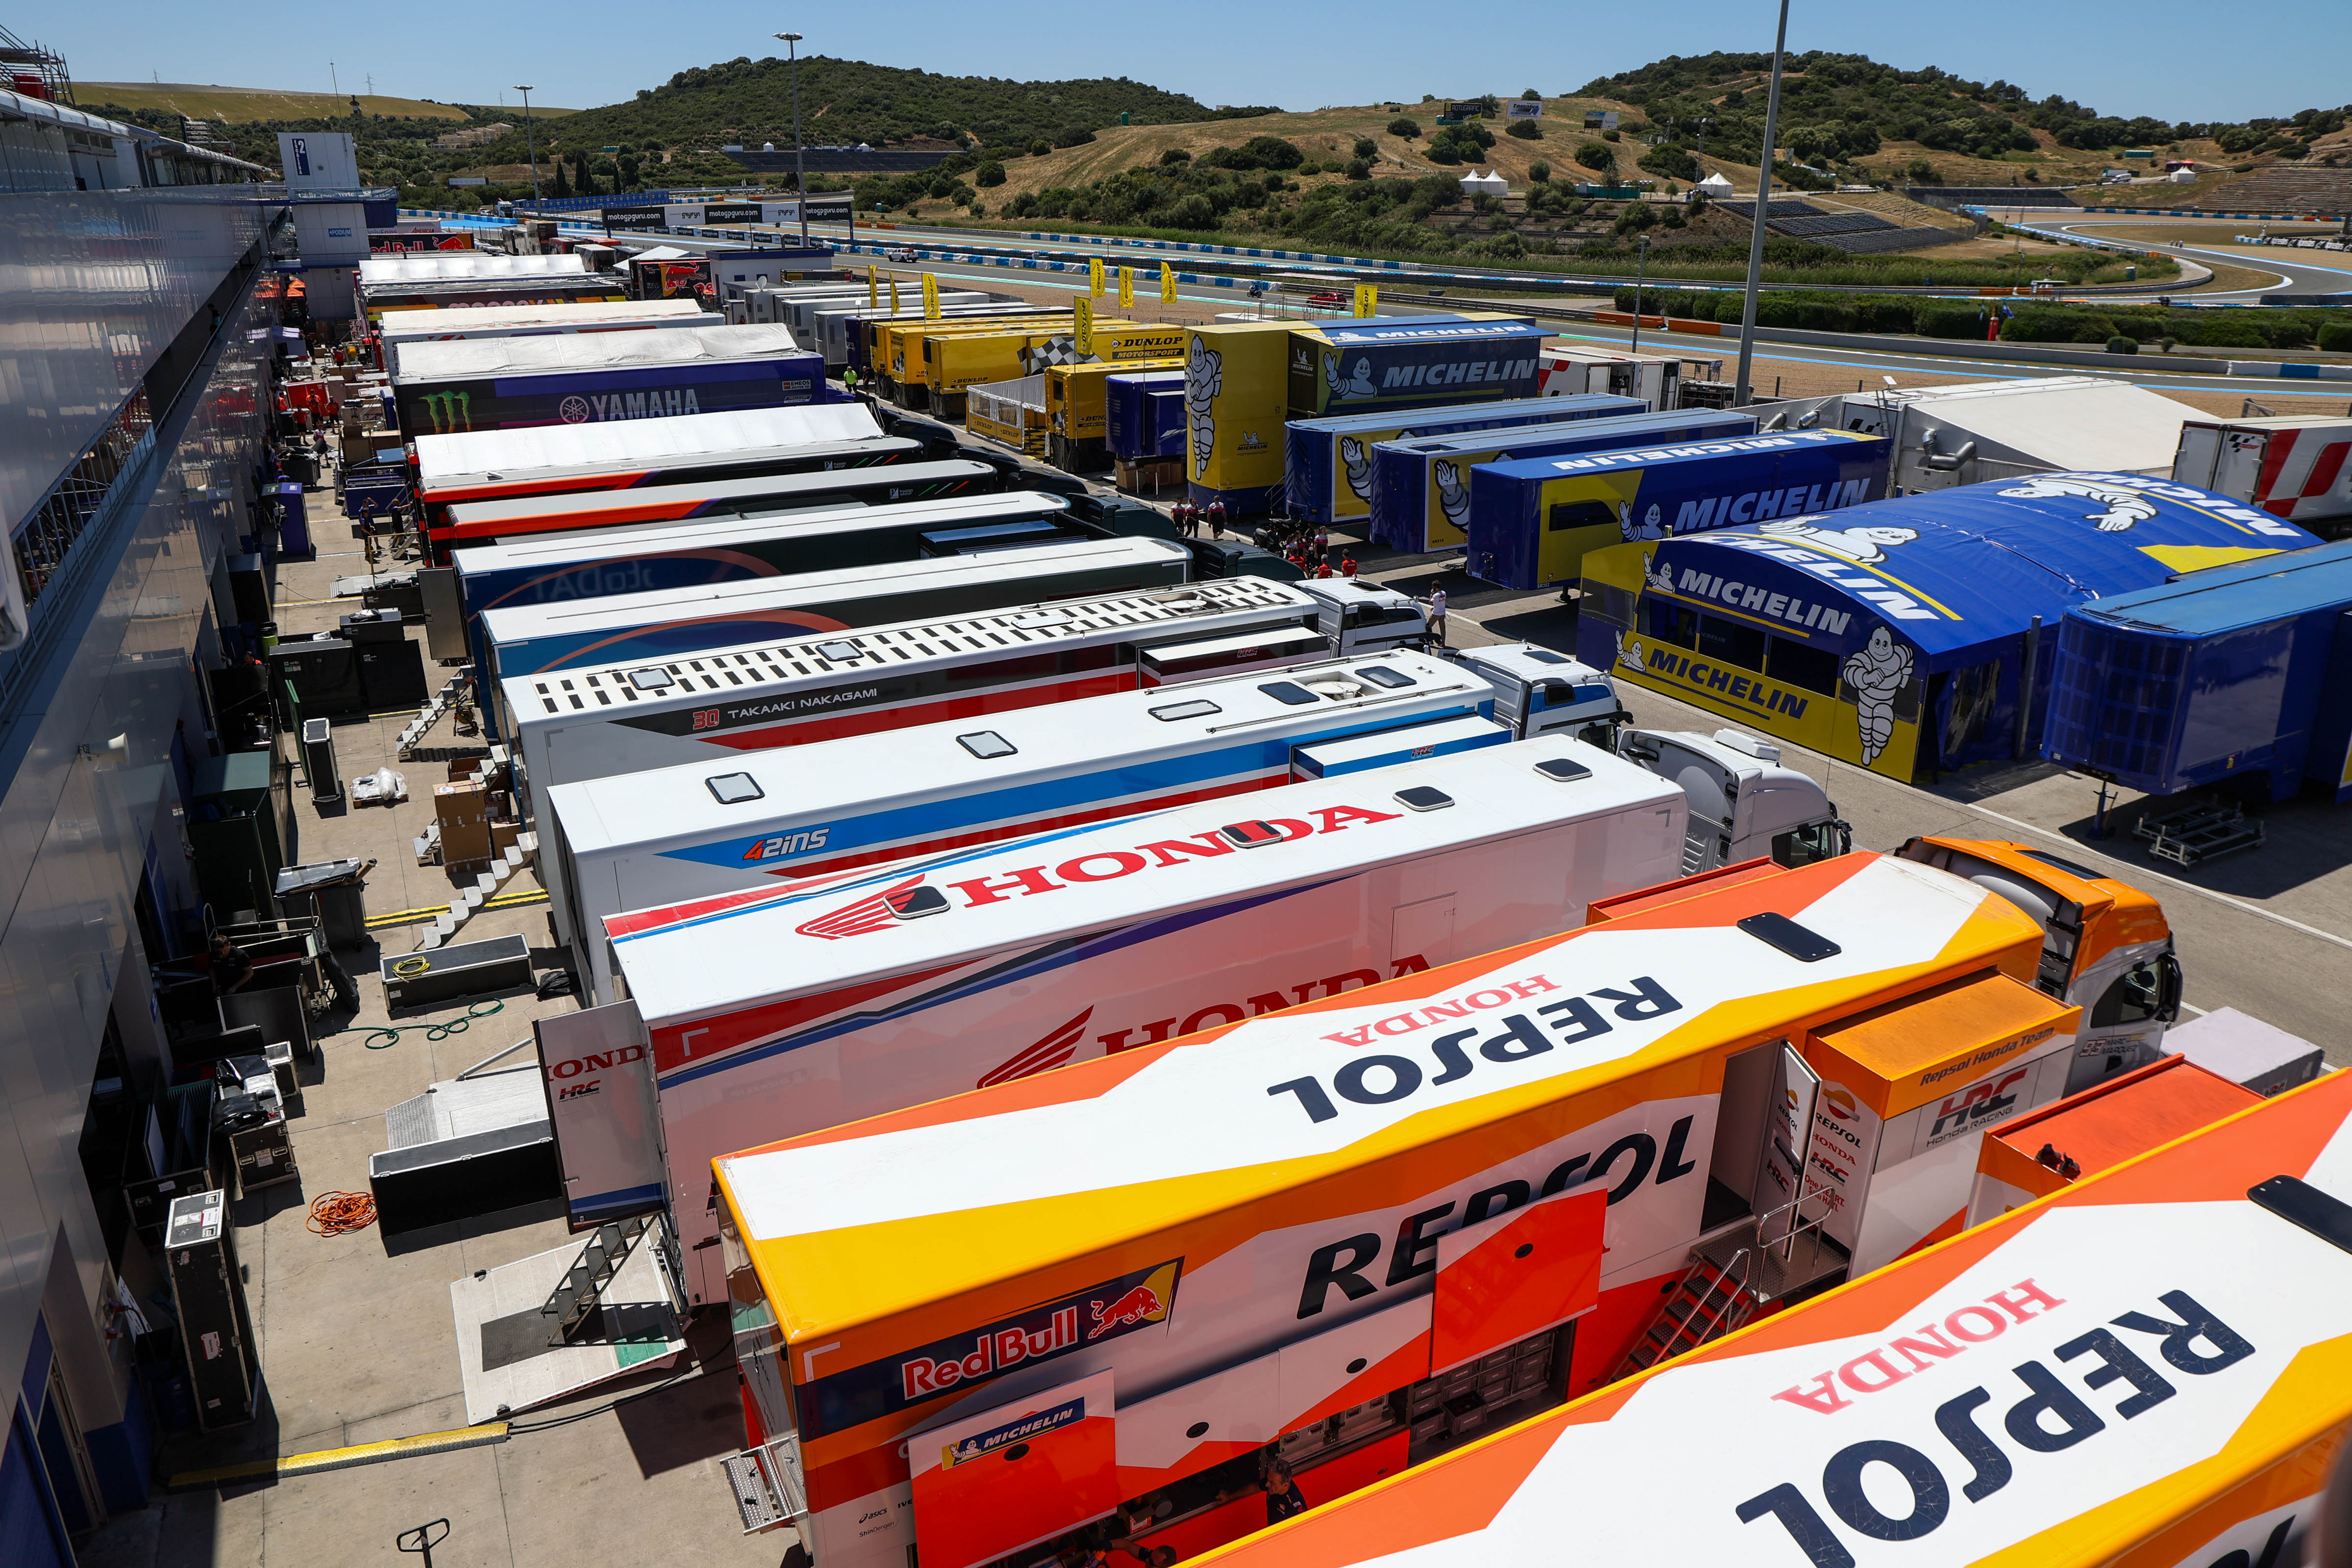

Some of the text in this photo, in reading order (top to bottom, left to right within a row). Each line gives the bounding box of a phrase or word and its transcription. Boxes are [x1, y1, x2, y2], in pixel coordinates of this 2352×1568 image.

[298, 140, 305, 153] 2
[608, 213, 661, 221] motogpguru.com
[709, 210, 758, 219] motogpguru.com
[1123, 337, 1183, 346] DUNLOP
[1375, 325, 1528, 339] MICHELIN
[1117, 349, 1179, 358] MOTORSPORT
[1293, 363, 1314, 371] MICHELIN
[1382, 358, 1537, 389] MICHELIN
[590, 389, 701, 422] YAMAHA
[977, 420, 992, 430] DUNLOP
[1002, 429, 1019, 439] DUNLOP
[1550, 438, 1797, 470] MICHELIN
[1673, 478, 1871, 531] MICHELIN
[1678, 568, 1852, 636] MICHELIN
[1647, 647, 1810, 720] MICHELIN
[728, 687, 878, 719] TAKAAKI NAKAGAMI
[692, 709, 720, 730] 30
[947, 805, 1404, 908] HONDA
[1319, 973, 1562, 1049] HONDA
[1266, 976, 1684, 1124] REPSOL
[1920, 1027, 2055, 1086] Repsol Honda Team
[560, 1079, 601, 1100] HRC
[1930, 1068, 2028, 1137] HRC
[1778, 1103, 1798, 1131] REPSOL
[1815, 1112, 1862, 1149] REPSOL
[1971, 1105, 2013, 1129] RACING
[1812, 1131, 1857, 1166] HONDA
[1804, 1174, 1819, 1188] One
[1809, 1151, 1850, 1183] HRC
[902, 1305, 1078, 1400] Red Bull
[1770, 1276, 2067, 1415] HONDA
[983, 1407, 1074, 1449] MICHELIN
[1735, 1289, 2256, 1568] REPSOL
[859, 1521, 894, 1537] ShinDengen
